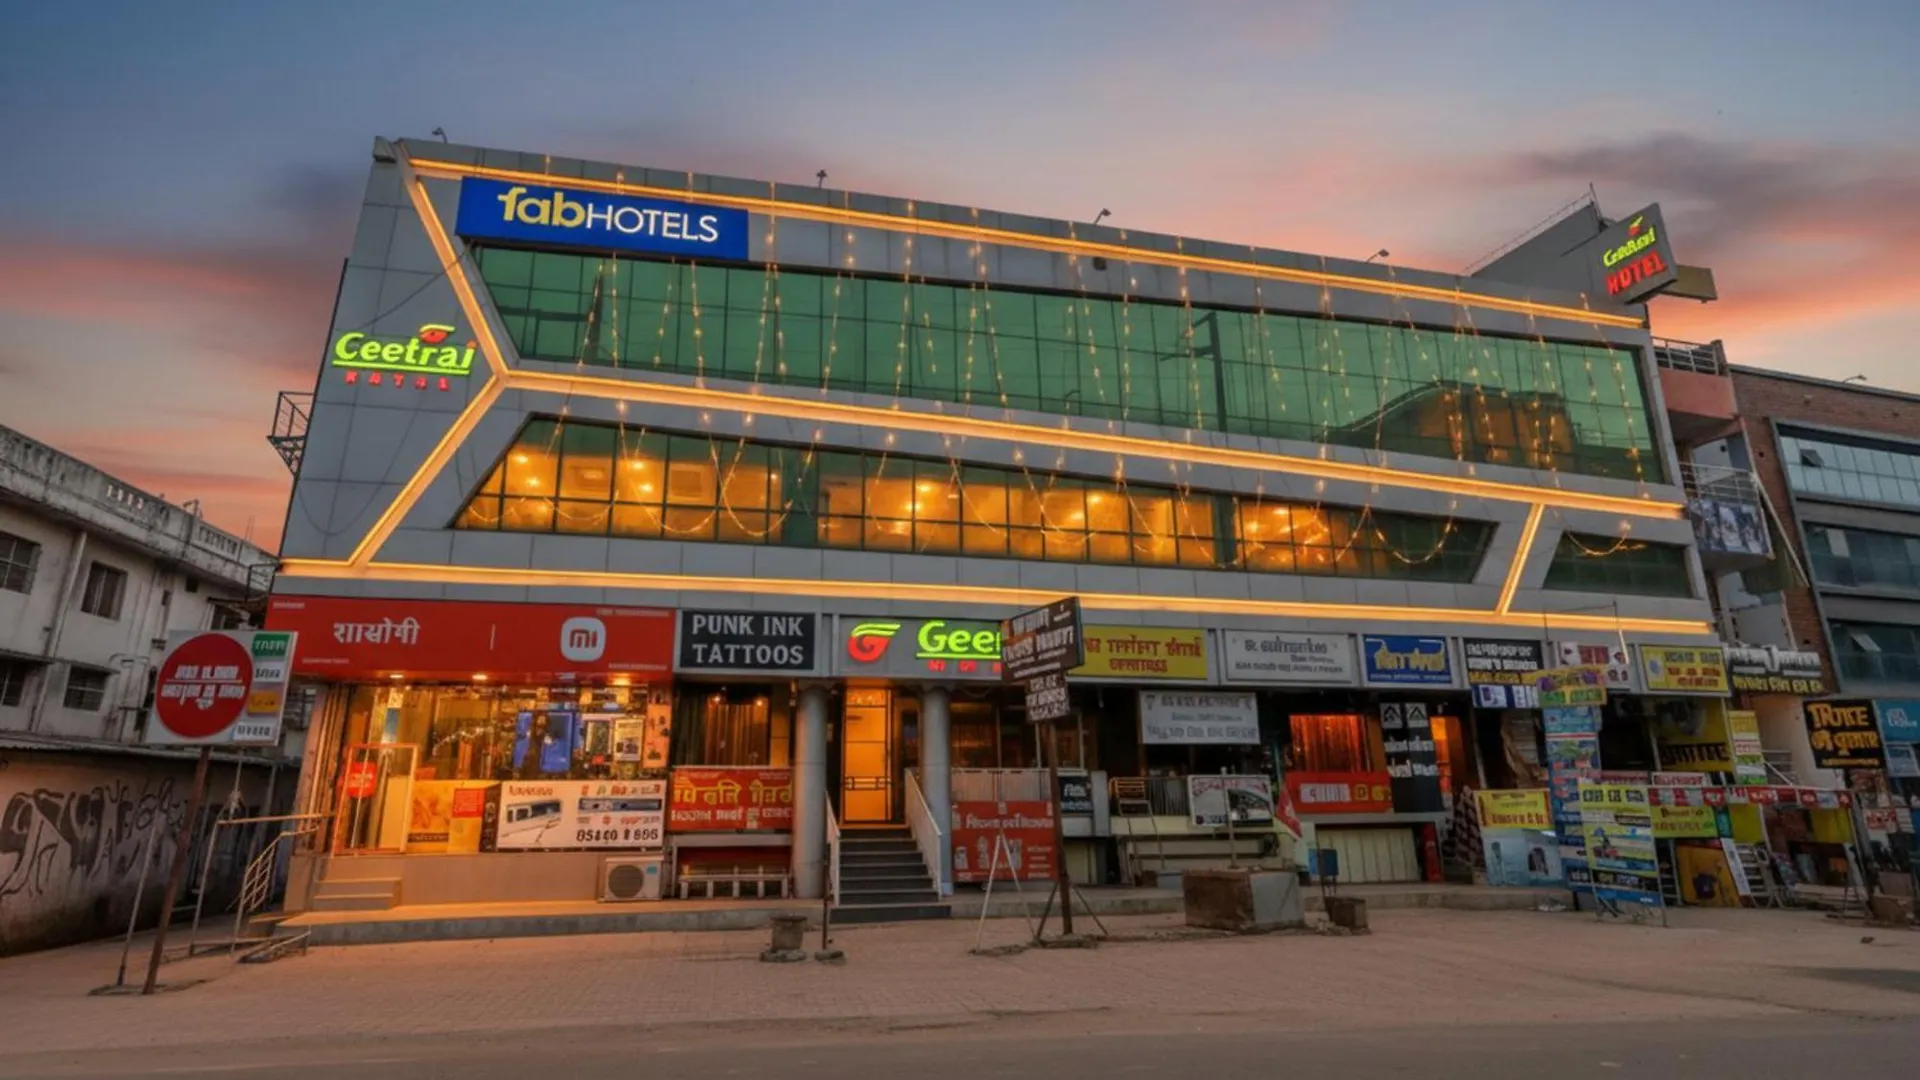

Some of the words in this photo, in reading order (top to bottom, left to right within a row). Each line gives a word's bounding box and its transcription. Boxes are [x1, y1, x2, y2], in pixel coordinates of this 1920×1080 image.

[497, 186, 719, 243] fabHOTELS
[691, 614, 755, 636] PUNK
[762, 615, 805, 637] INK
[917, 620, 1001, 653] Gee
[691, 643, 805, 665] TATTOOS
